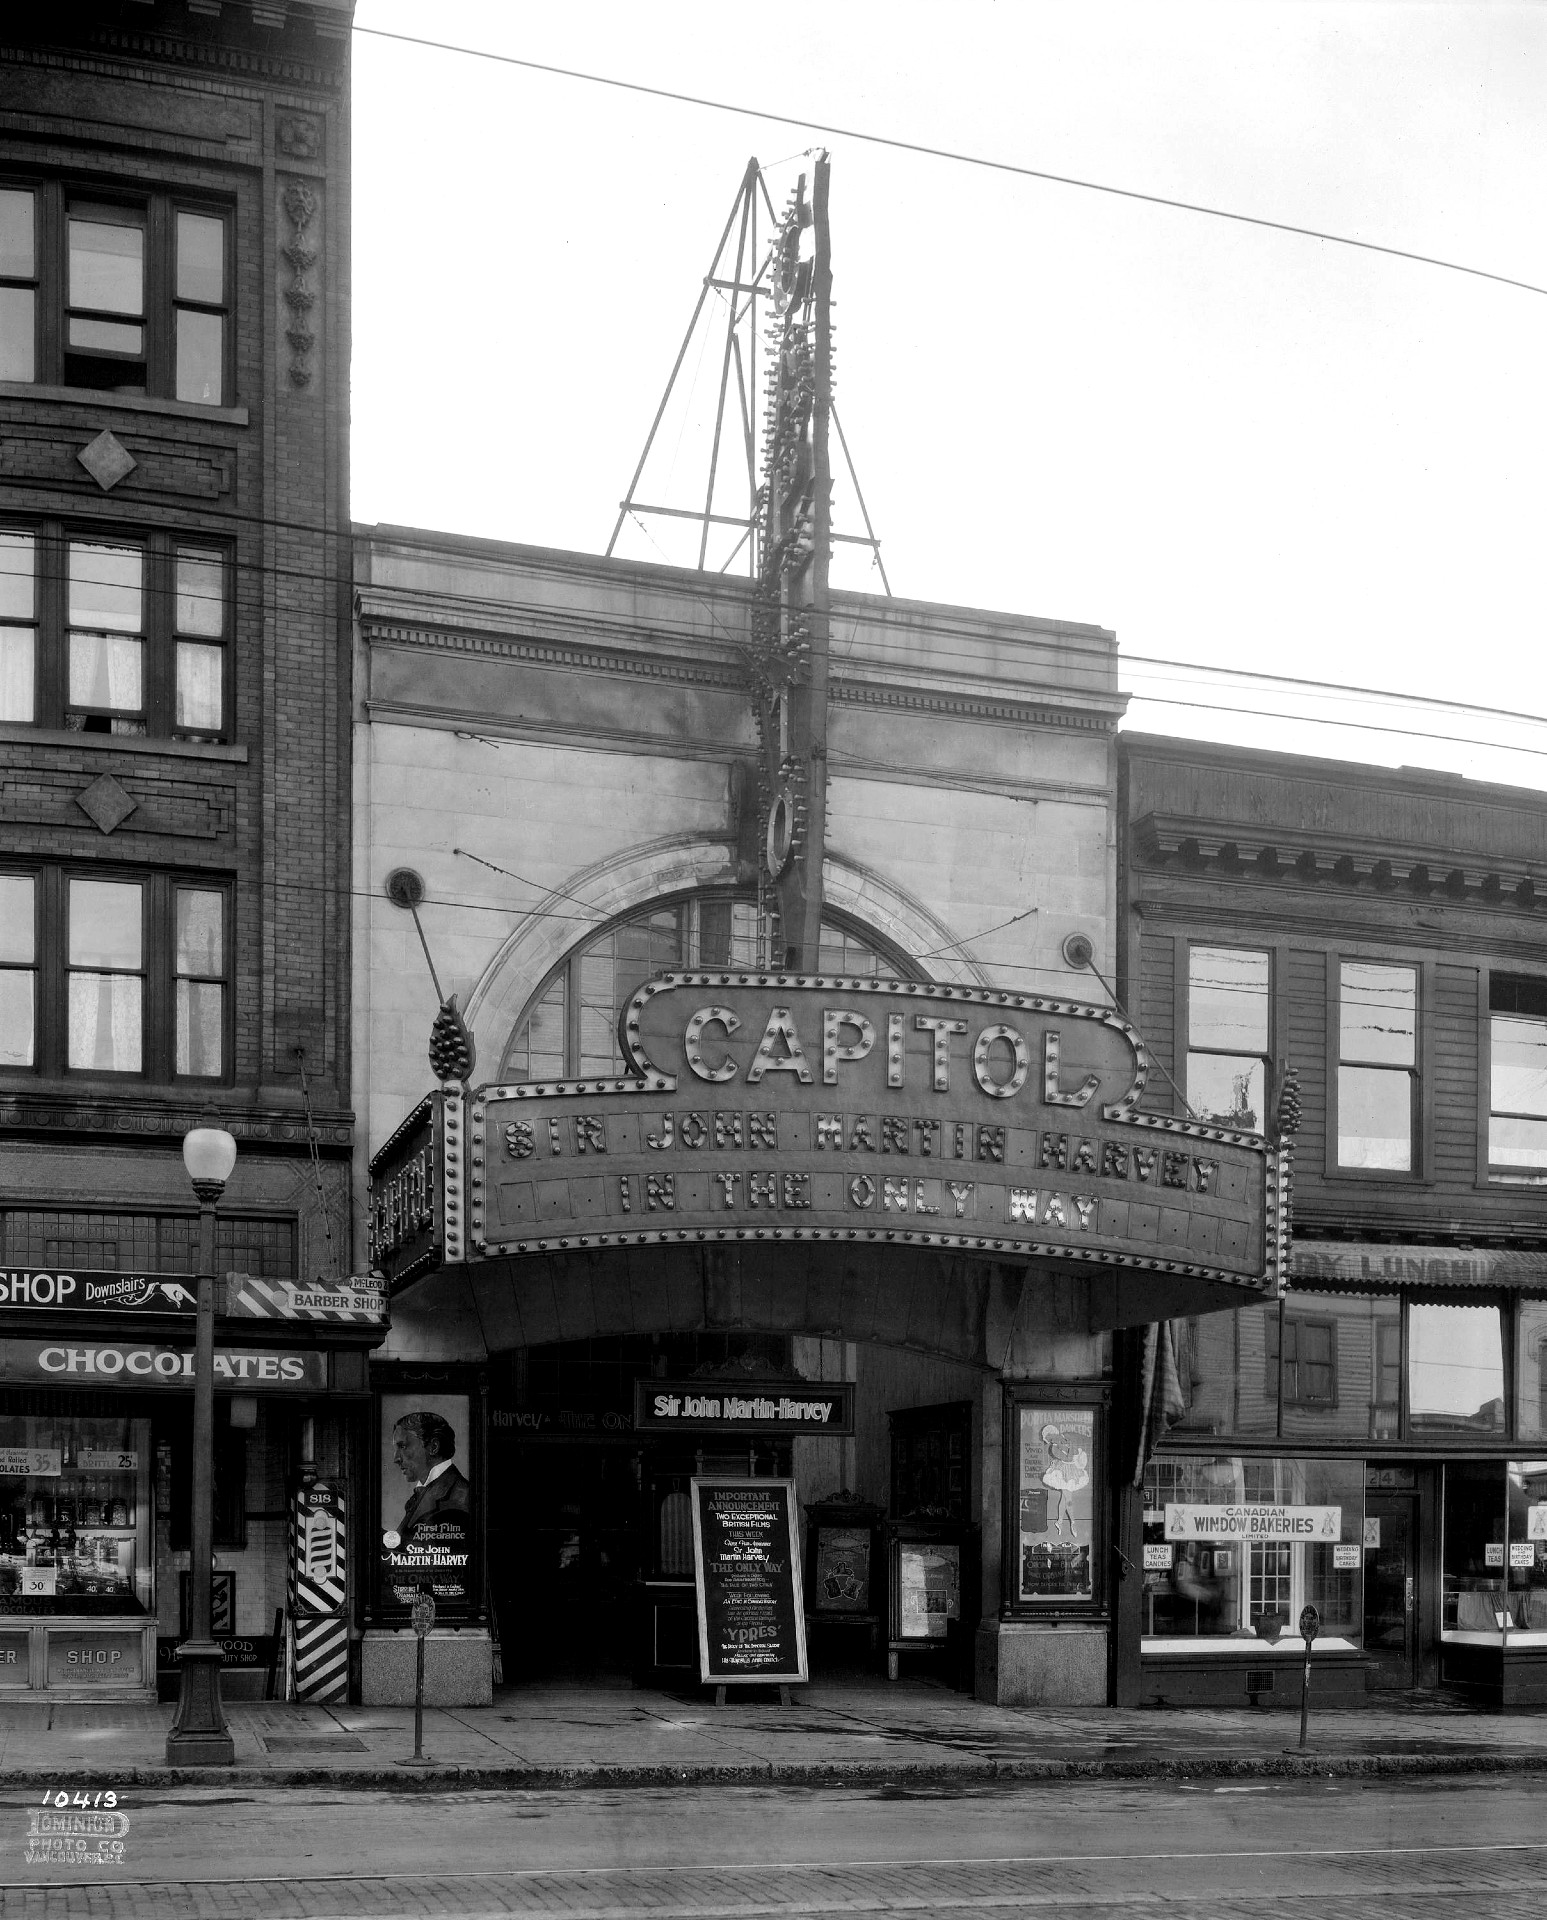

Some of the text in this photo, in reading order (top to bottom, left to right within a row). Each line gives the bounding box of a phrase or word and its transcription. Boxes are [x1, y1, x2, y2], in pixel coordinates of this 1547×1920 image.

[684, 1005, 1100, 1108] CAPITOL
[505, 1112, 1219, 1193] SIR JOHN MARTIN HARVEY
[621, 1173, 1100, 1231] IN THE ONLY WAY
[1361, 1256, 1472, 1284] LUNCH
[0, 1271, 146, 1304] SHOP Downstairs
[294, 1294, 349, 1308] BARBER
[353, 1297, 384, 1311] SHOP
[653, 1395, 832, 1423] Sir John Martin-Harvey
[492, 1409, 543, 1430] Harvey
[310, 1494, 331, 1504] 818
[714, 1492, 771, 1501] IMPORTANT
[708, 1501, 780, 1511] ANNOUNCEMENT
[1225, 1507, 1286, 1517] CANADIAN
[715, 1512, 778, 1521] TWO EXCEPTIONAL
[413, 1521, 461, 1533] First Film
[1194, 1516, 1314, 1534] WINDOW BAKERIES
[413, 1531, 466, 1541] Appearance
[406, 1544, 450, 1555] SIR JOHN
[1146, 1546, 1169, 1554] LUNCH
[381, 1552, 469, 1566] MARTIN-HARVEY
[742, 1554, 769, 1563] Harvey
[735, 1562, 761, 1573] ONLY
[66, 1649, 122, 1664] SHOP
[241, 1654, 258, 1662] SHOP
